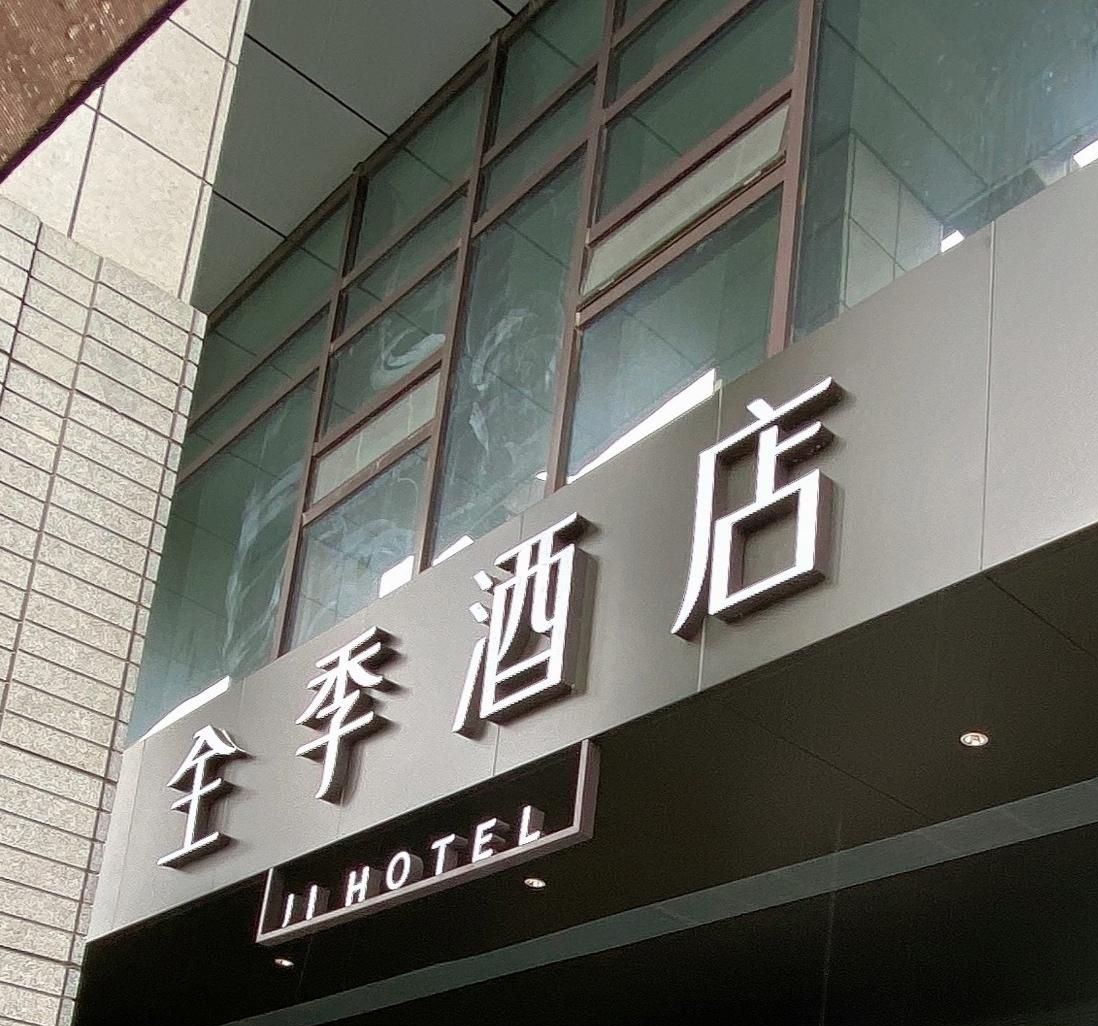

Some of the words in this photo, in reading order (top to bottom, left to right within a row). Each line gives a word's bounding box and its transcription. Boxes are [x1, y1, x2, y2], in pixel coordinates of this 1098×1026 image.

[157, 376, 838, 868] 全季酒店
[281, 883, 320, 929] JI
[344, 804, 542, 908] HOTEL
